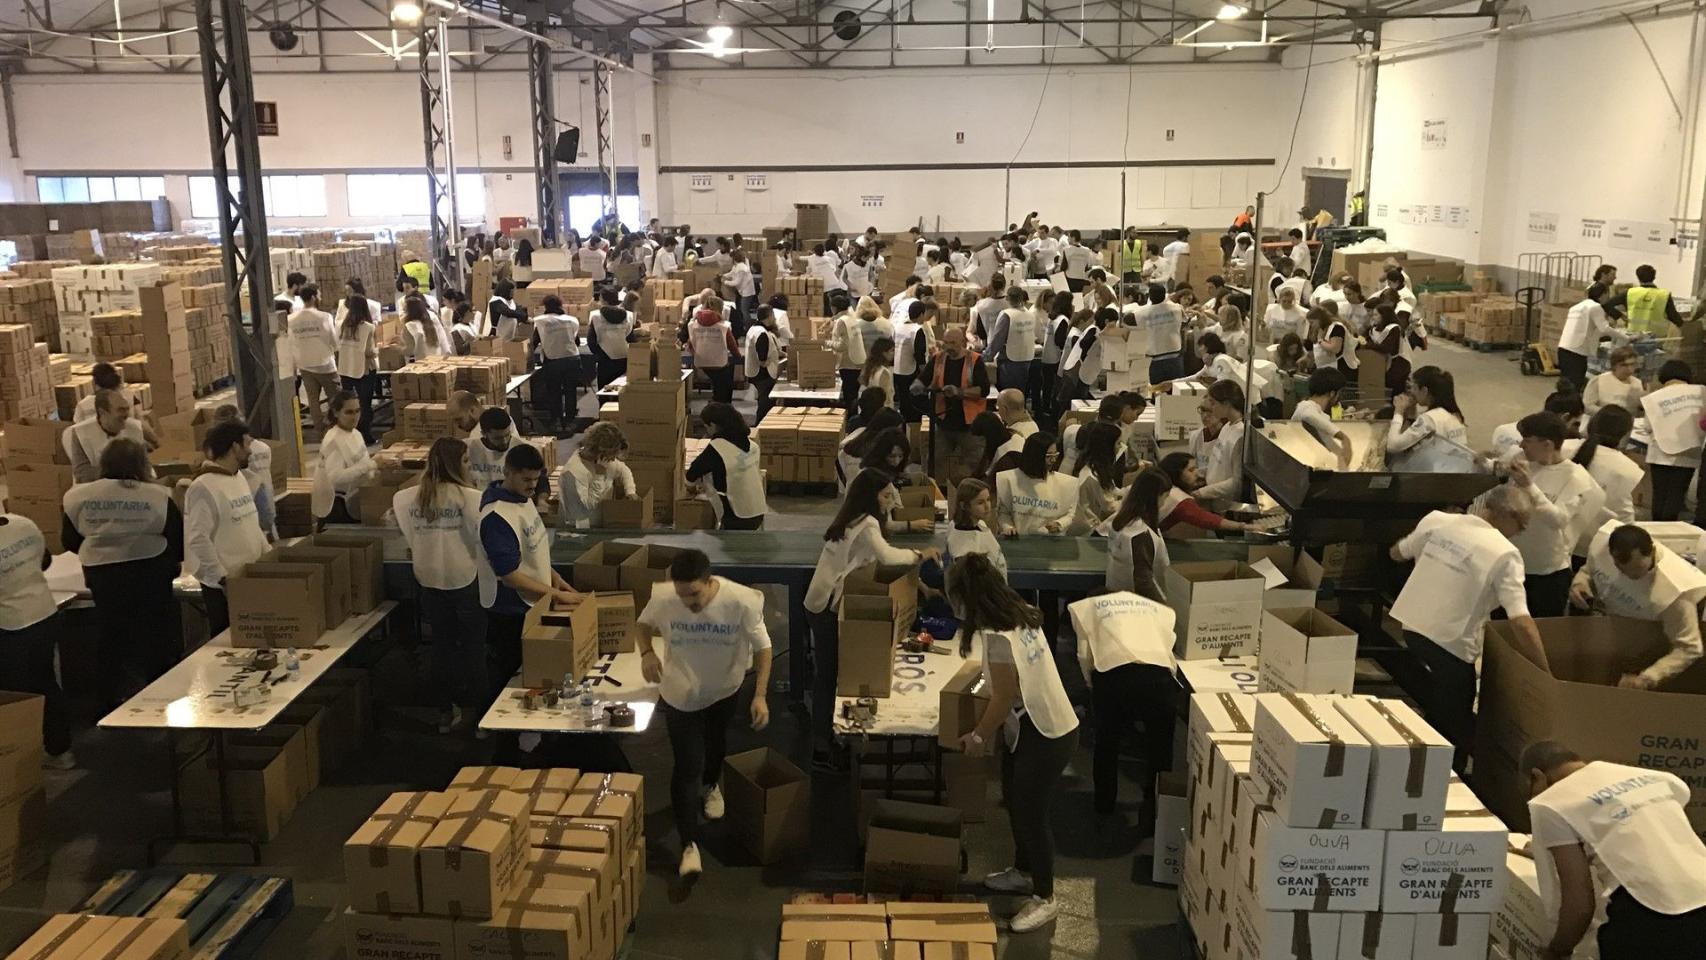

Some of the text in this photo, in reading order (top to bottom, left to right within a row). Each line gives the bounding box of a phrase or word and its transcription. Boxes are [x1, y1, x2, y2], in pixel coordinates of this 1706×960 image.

[1640, 735, 1699, 751] GRAN
[1638, 753, 1706, 769] RECAP
[1276, 876, 1314, 887] GRAN
[1399, 879, 1493, 889] GRAN RAPTE
[1287, 887, 1357, 897] D'ALIENTS
[1409, 889, 1481, 899] D'ALINTS
